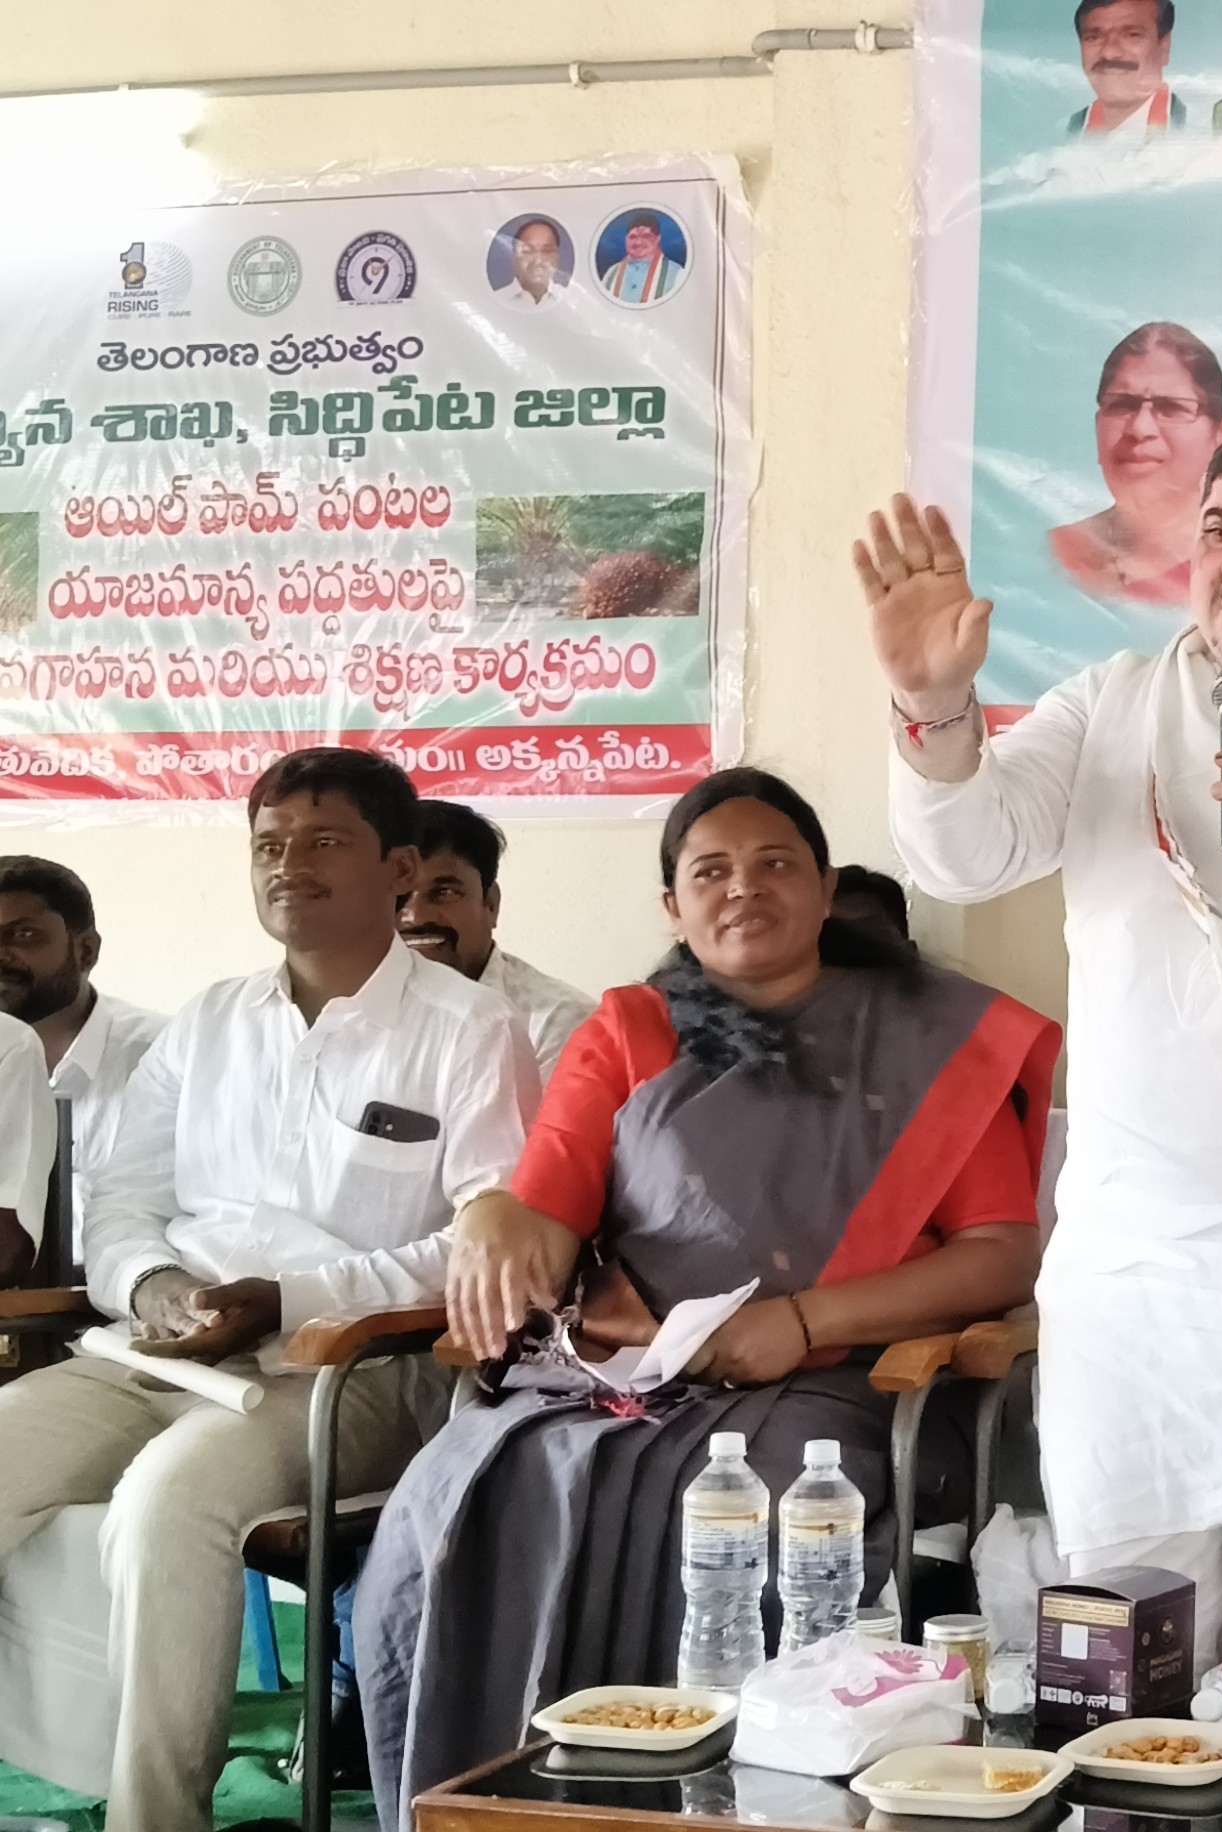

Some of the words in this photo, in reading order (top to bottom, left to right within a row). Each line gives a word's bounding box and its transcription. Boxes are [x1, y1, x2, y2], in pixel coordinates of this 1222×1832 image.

[107, 300, 159, 312] RISING
[109, 290, 159, 298] TELANGANA
[97, 341, 259, 372] తెలంగాణ
[266, 331, 424, 375] ప్రభుత్వం
[90, 401, 248, 448] శాఖ,
[269, 375, 495, 462] సిద్ధిపేట
[514, 386, 666, 440] జిల్లా
[64, 474, 192, 538] ఆయిల్
[199, 472, 298, 533] పామ్
[318, 473, 450, 530] పంటల
[48, 562, 270, 641] యాజమాన్య
[167, 643, 327, 698] మరియు
[342, 642, 443, 720] శిక్షణ
[452, 636, 656, 717] కార్యక్రమం
